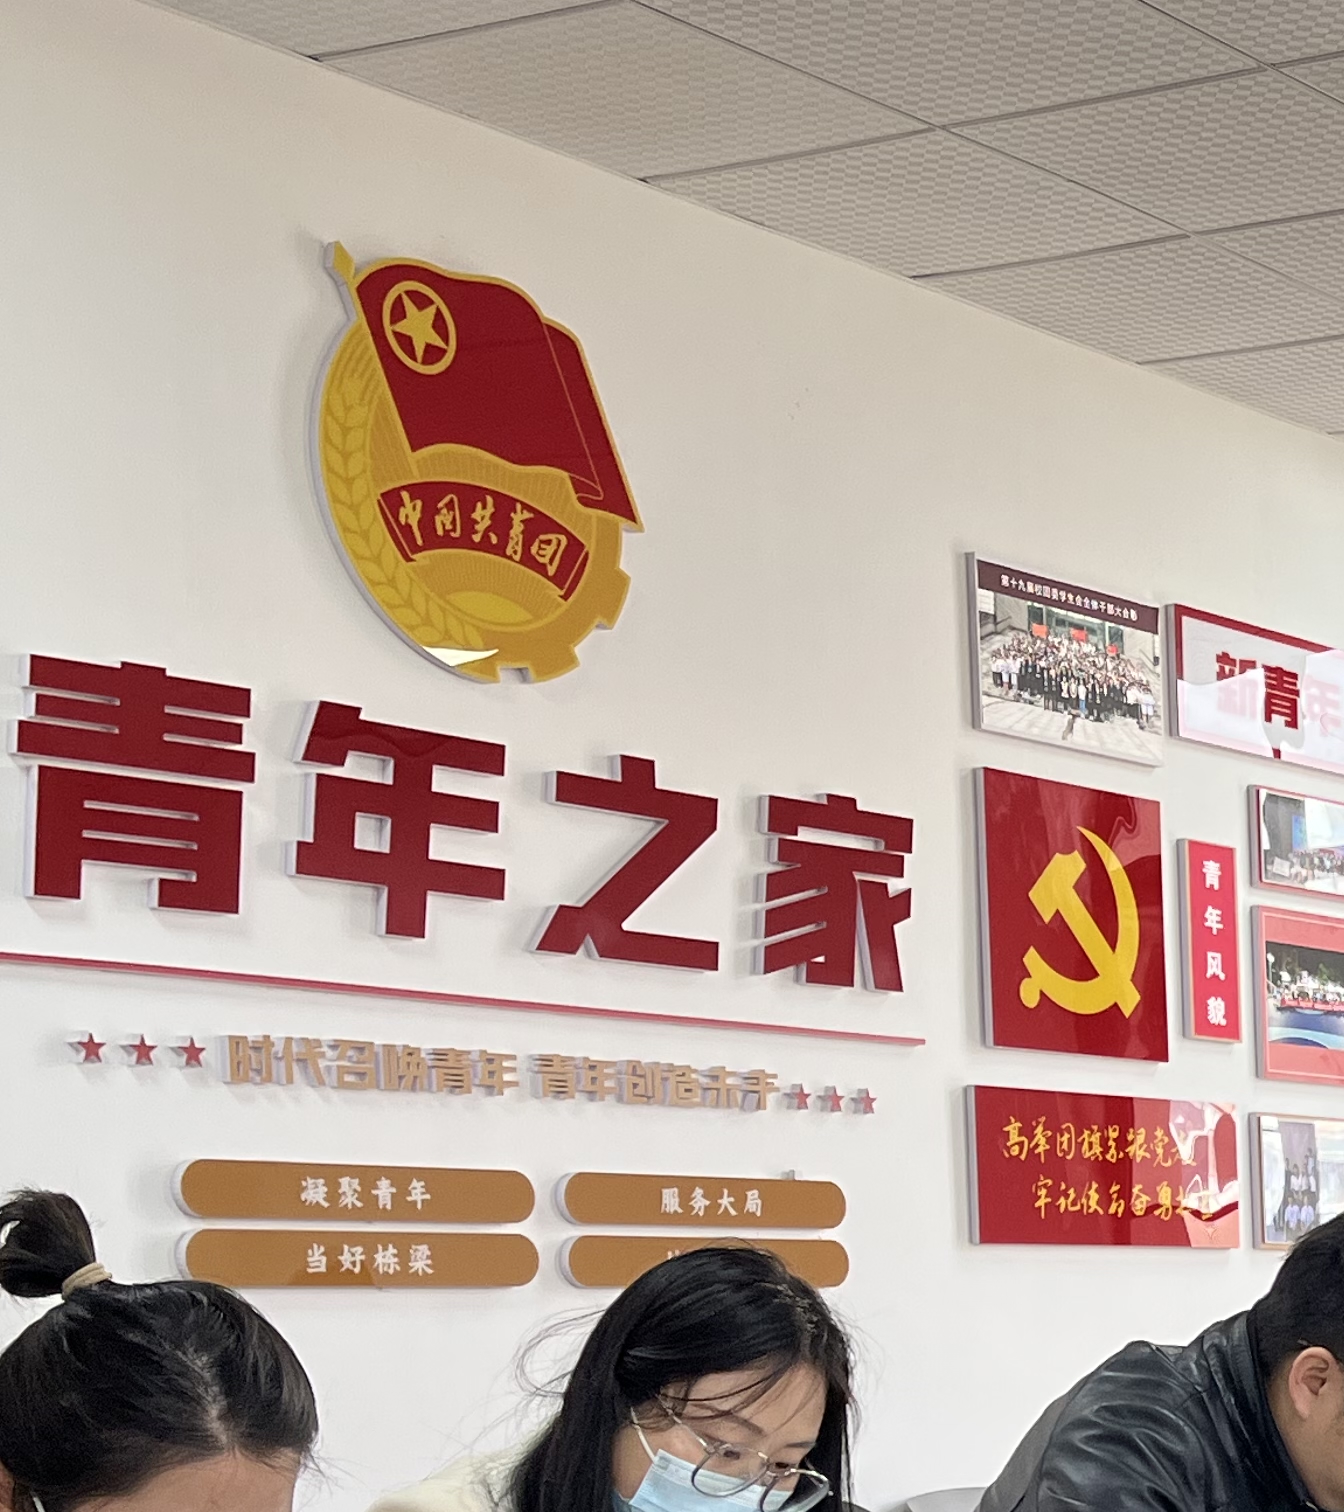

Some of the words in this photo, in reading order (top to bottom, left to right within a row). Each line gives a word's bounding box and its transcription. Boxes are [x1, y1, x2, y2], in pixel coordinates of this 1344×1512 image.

[399, 490, 568, 577] 中国共青团
[15, 653, 914, 993] 青年之家
[1202, 860, 1228, 1027] 青年风貌
[222, 1034, 520, 1096] 时代召唤青年
[300, 1176, 431, 1212] 凝聚青年
[660, 1186, 763, 1217] 服务大局
[1031, 1173, 1213, 1220] 牢记使命奋勇
[306, 1242, 435, 1276] 当好栋梁
